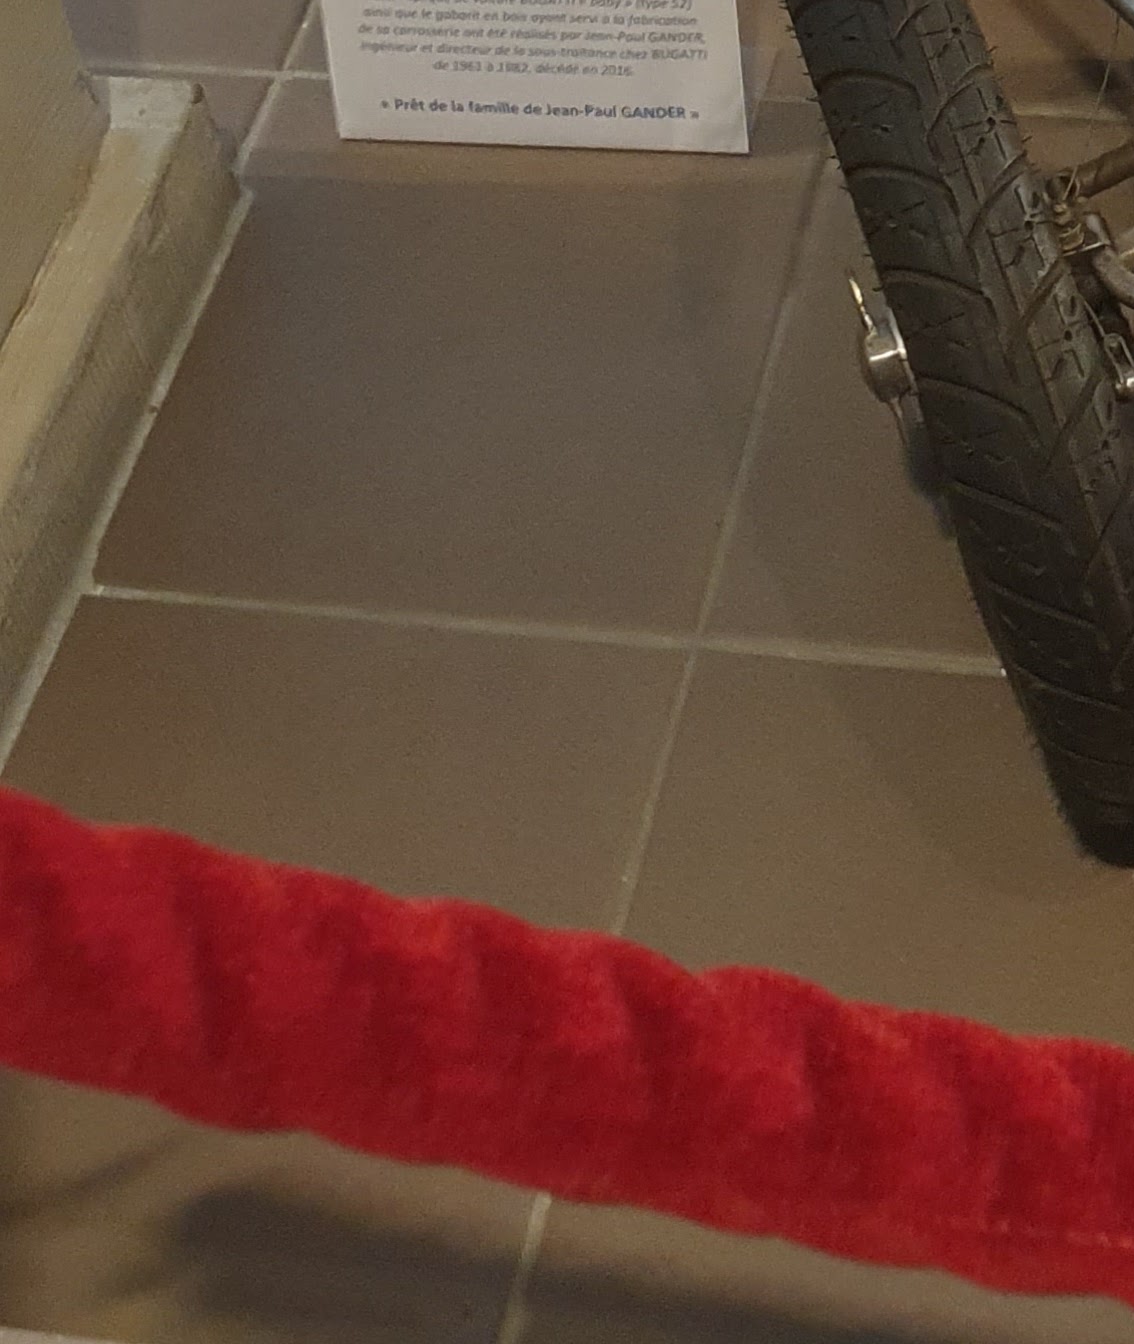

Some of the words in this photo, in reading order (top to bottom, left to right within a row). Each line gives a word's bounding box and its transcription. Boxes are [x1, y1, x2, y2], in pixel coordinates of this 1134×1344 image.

[395, 9, 418, 19] que
[421, 9, 432, 19] le
[435, 10, 480, 22] gabarit
[483, 12, 499, 21] en
[503, 11, 527, 22] bois
[530, 13, 567, 25] ayant
[569, 14, 598, 24] servi
[613, 14, 625, 25] la
[627, 14, 698, 28] fabrication
[357, 23, 373, 34] de
[376, 26, 390, 35] sa
[393, 26, 460, 38] carrosserie
[462, 28, 484, 38] ont
[559, 31, 582, 42] par
[584, 31, 645, 43] Jean-Paul
[648, 31, 706, 45] GANDER,
[420, 43, 433, 53] et
[436, 43, 492, 55] directeur
[494, 44, 511, 56] de
[513, 45, 526, 56] la
[619, 47, 648, 60] chez
[651, 48, 708, 61] BUGATTI
[432, 60, 450, 71] de
[582, 65, 599, 74] en
[394, 97, 425, 112] Prêt
[428, 98, 449, 113] de
[451, 99, 465, 113] la
[467, 100, 520, 115] famille
[523, 102, 543, 115] de
[546, 103, 617, 118] Jean-Paul
[621, 105, 687, 120] GANDER
